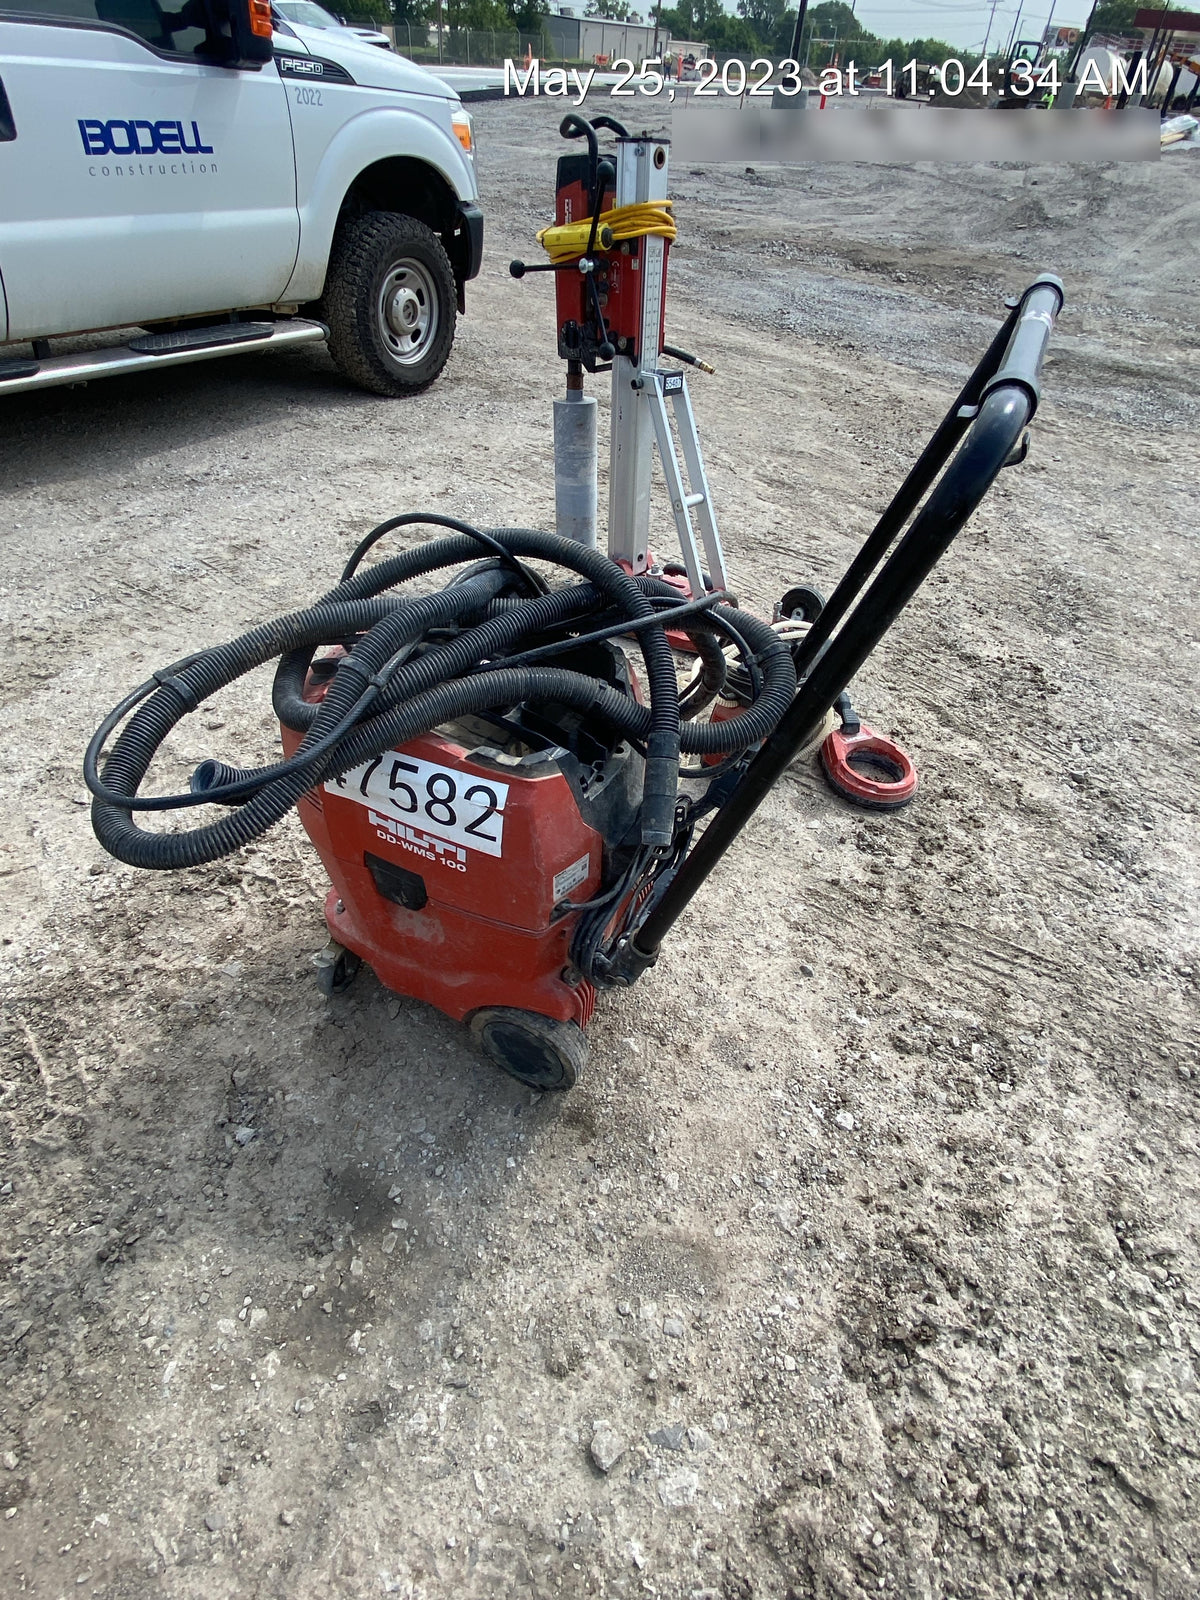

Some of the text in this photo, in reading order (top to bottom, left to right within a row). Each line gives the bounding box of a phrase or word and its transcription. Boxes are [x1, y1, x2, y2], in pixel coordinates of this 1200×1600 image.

[294, 86, 323, 107] 2022
[77, 119, 214, 156] BODELL
[88, 161, 219, 177] construction
[367, 809, 467, 862] HILTI
[376, 829, 468, 873] DD-WMS 100
